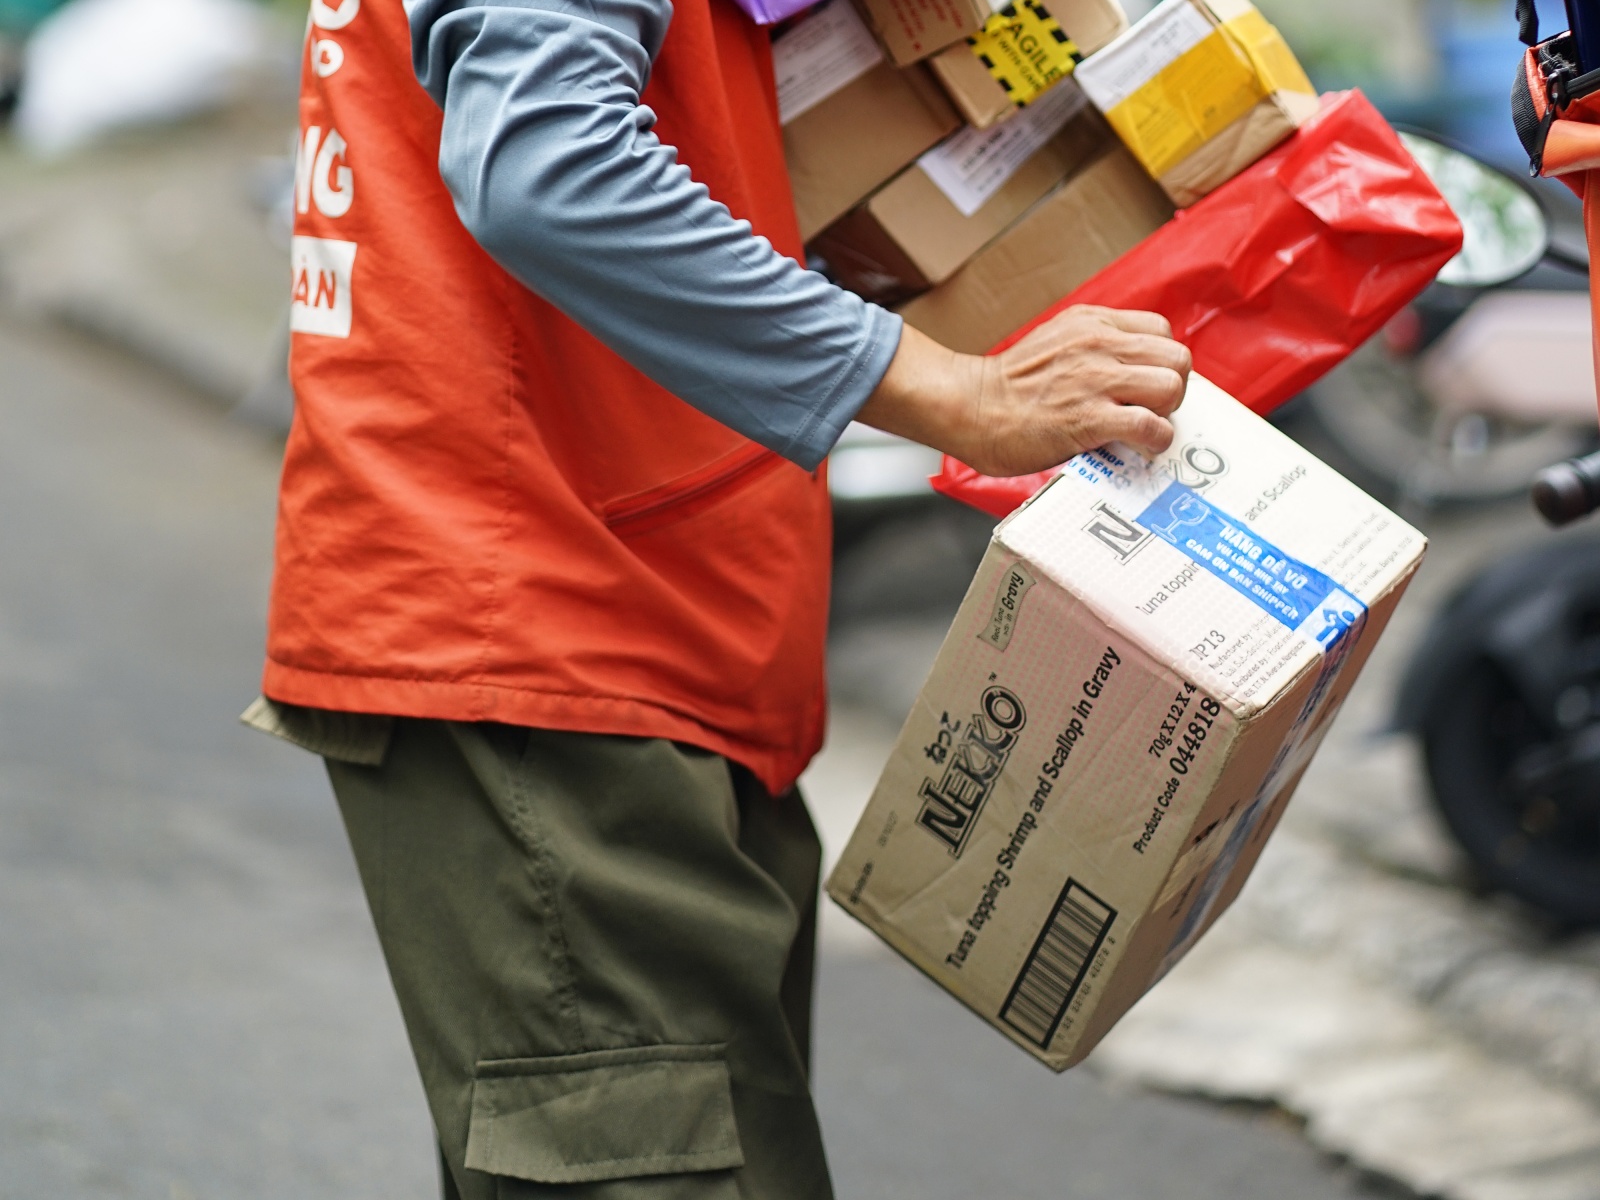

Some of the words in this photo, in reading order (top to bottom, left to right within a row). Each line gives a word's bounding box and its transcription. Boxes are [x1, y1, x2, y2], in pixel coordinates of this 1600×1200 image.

[1007, 23, 1060, 81] AGILE
[1163, 561, 1199, 594] toppin
[1245, 499, 1268, 521] and
[1216, 542, 1233, 557] VUI
[1001, 571, 1024, 611] Gravy
[1082, 645, 1121, 697] Gravy
[1075, 697, 1094, 720] in
[915, 685, 1026, 860] NEKKO
[1042, 716, 1085, 780] Scallop
[1132, 807, 1166, 854] Product
[1157, 776, 1180, 808] Code
[1169, 697, 1221, 774] 044818
[1029, 775, 1052, 814] and
[996, 810, 1039, 871] Shrimp
[967, 868, 1010, 933] topping
[946, 928, 977, 970] Tuna
